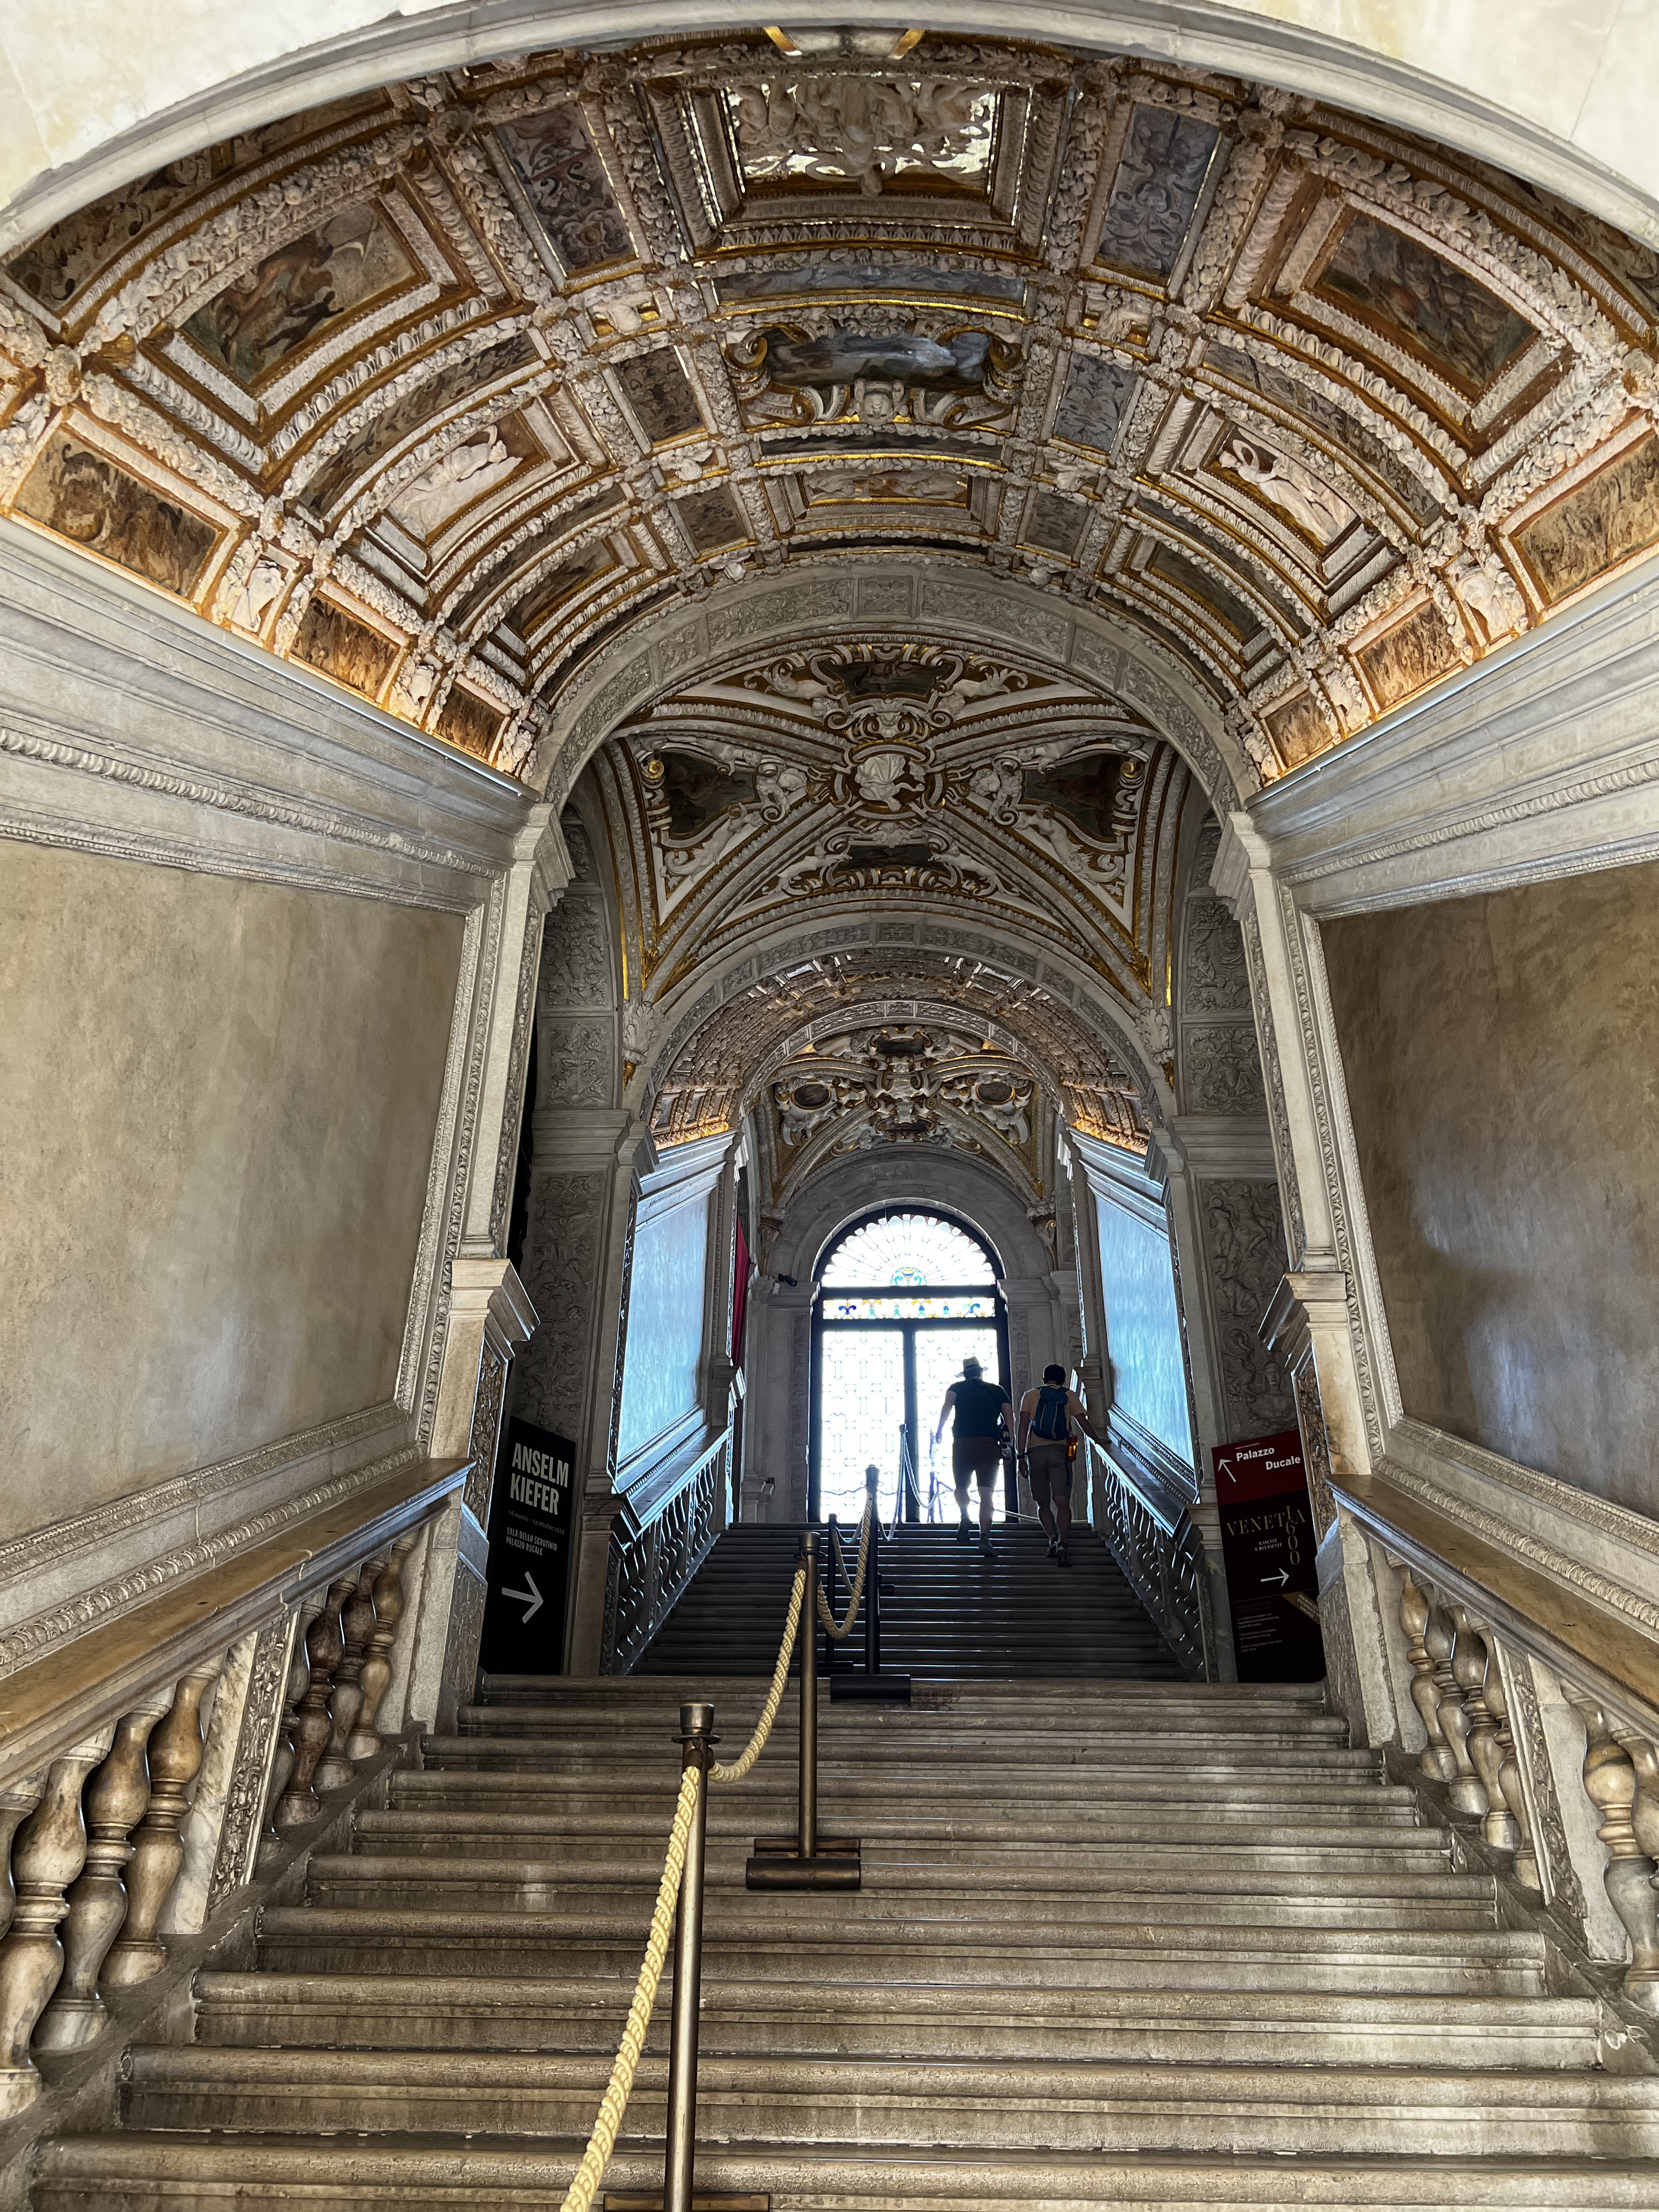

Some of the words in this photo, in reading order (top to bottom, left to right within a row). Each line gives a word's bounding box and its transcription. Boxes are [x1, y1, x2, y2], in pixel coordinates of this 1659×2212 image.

[512, 1442, 569, 1488] ANSELM
[1236, 1446, 1275, 1462] Palazzo
[1265, 1455, 1301, 1470] Ducale
[510, 1473, 559, 1515] KIEFER
[514, 1513, 529, 1521] marzo
[538, 1521, 554, 1531] ottobre
[554, 1526, 565, 1535] 2022
[1226, 1506, 1306, 1536] VENETIA
[505, 1536, 525, 1550] PALAZZO
[525, 1543, 544, 1556] DUCALE
[507, 1526, 519, 1537] SALA
[519, 1531, 534, 1543] DELLO
[534, 1536, 557, 1551] SCRUTINIO
[1259, 1542, 1282, 1551] RINASCITE
